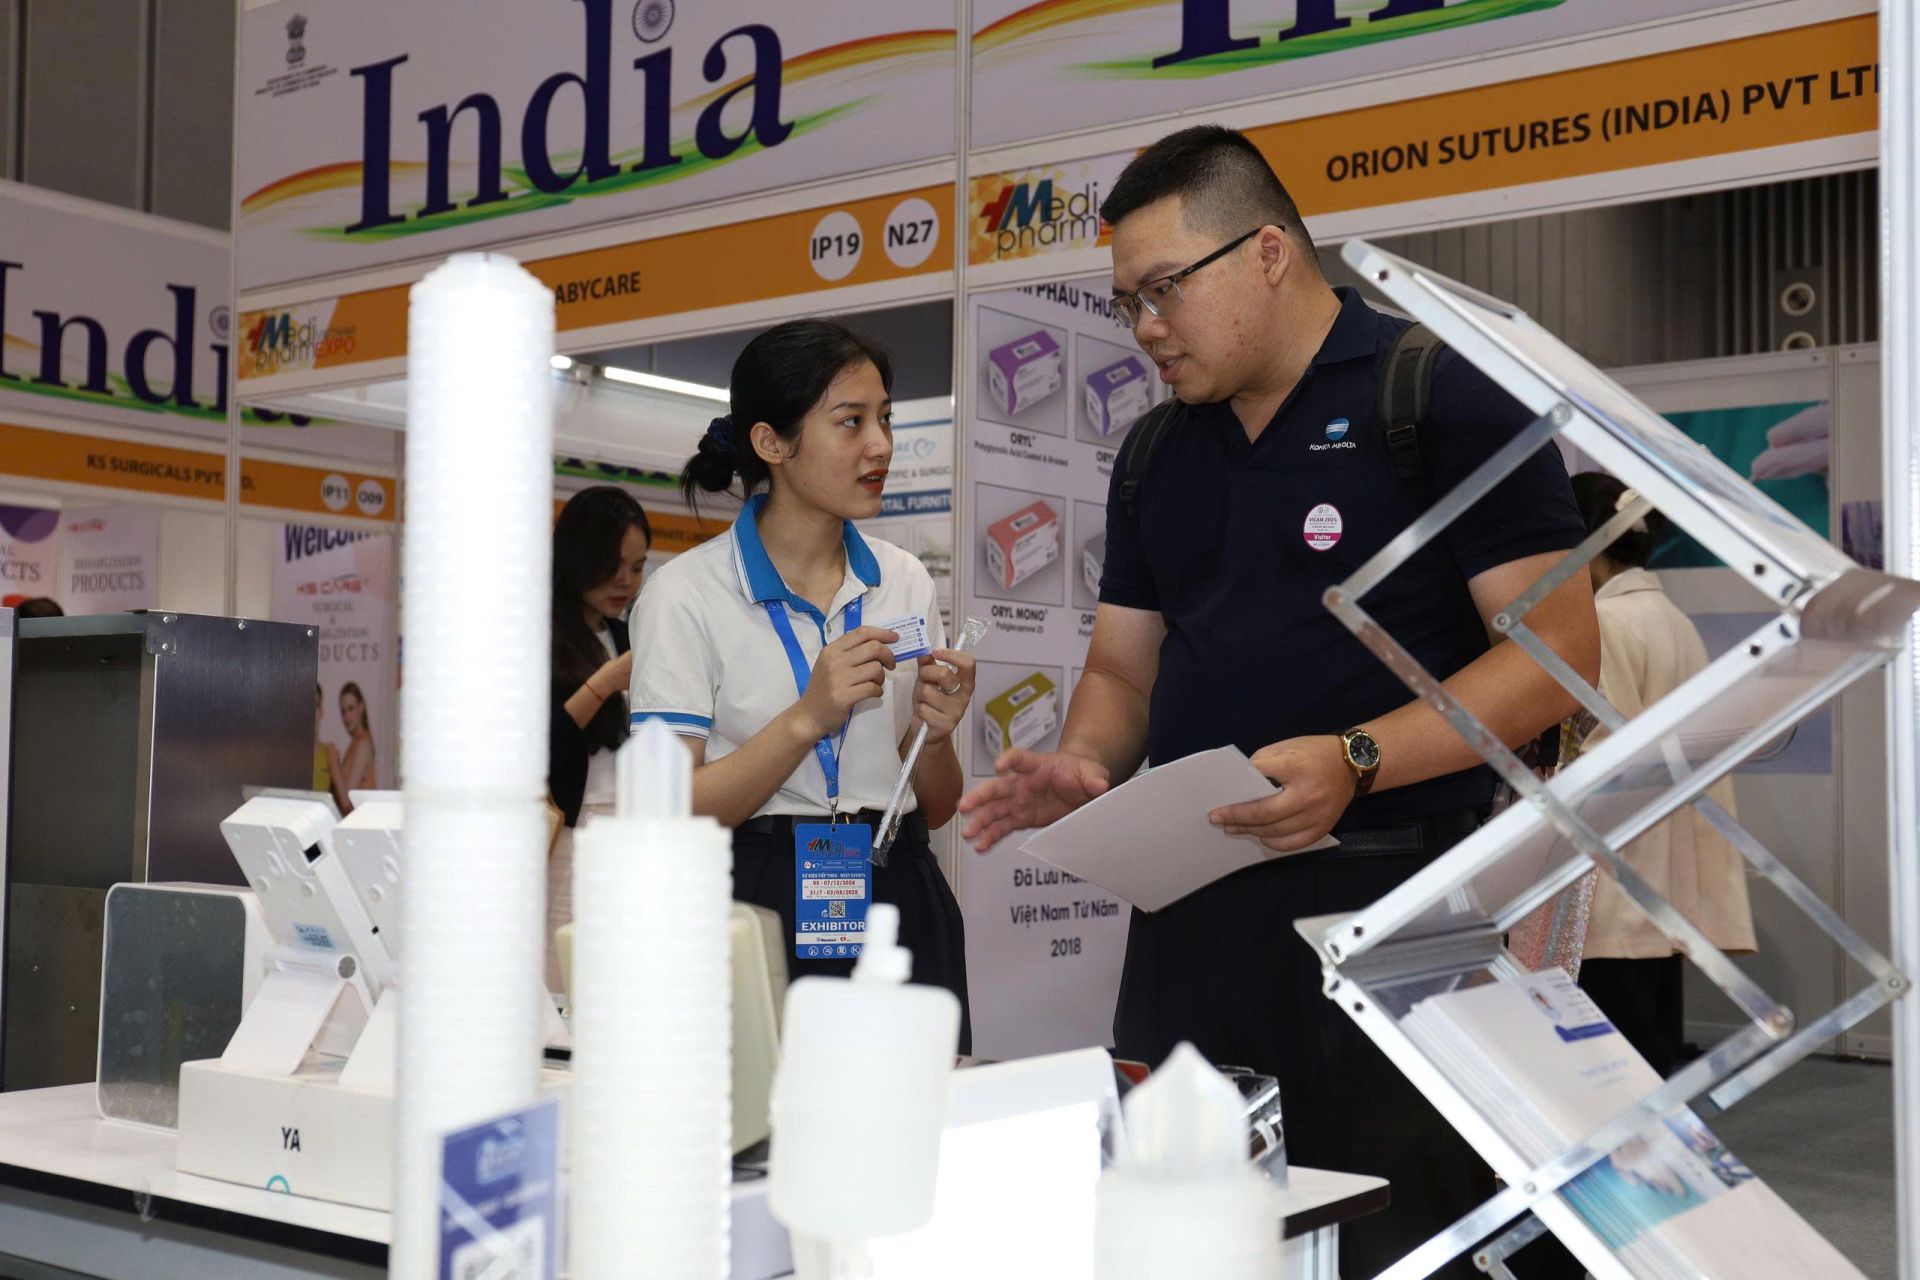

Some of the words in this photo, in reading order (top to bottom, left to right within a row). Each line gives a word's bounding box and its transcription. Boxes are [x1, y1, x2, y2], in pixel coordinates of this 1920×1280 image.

[344, 0, 795, 234] India
[1326, 141, 1429, 183] ORION
[1438, 112, 1592, 166] SUTURES
[1602, 89, 1731, 142] (INDIA)
[1742, 74, 1819, 115] PVT
[1830, 62, 1880, 101] LT
[811, 232, 860, 261] IP19
[888, 218, 934, 248] N27
[555, 270, 642, 305] ABYCARE
[86, 454, 106, 470] KS
[110, 455, 191, 482] SURGICALS
[71, 571, 146, 593] PRODUCTS
[801, 921, 865, 931] EXHIBITOR
[1040, 903, 1070, 921] Nam
[1051, 937, 1082, 957] 2018
[281, 1126, 302, 1152] YA
